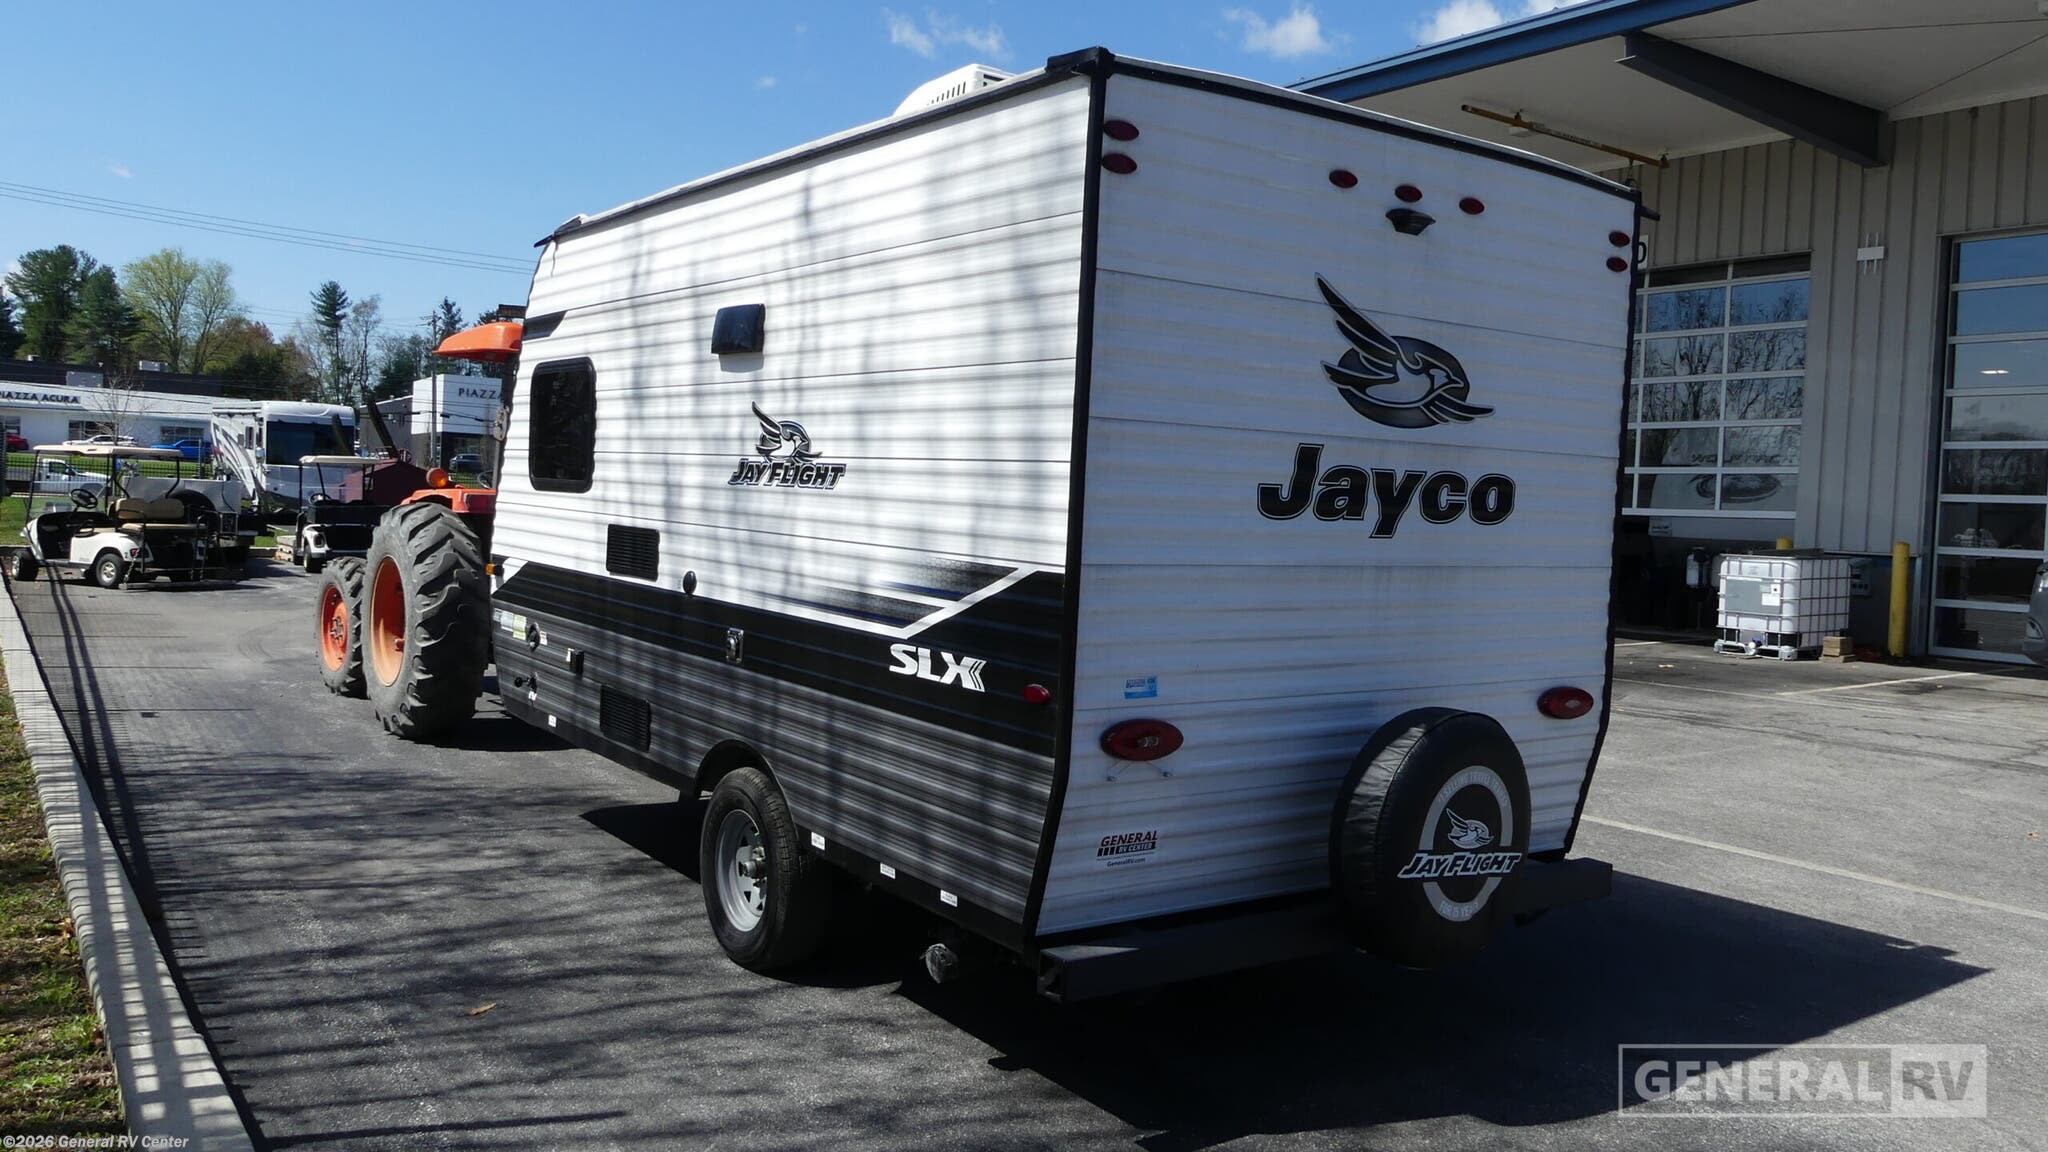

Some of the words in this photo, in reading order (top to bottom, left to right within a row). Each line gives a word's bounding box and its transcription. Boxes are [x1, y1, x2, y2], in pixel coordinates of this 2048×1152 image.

[41, 394, 79, 403] ACURA
[458, 388, 502, 399] PIAZZ
[1257, 442, 1516, 539] Jayco
[889, 643, 987, 692] SLX
[1101, 830, 1158, 847] GENERAL
